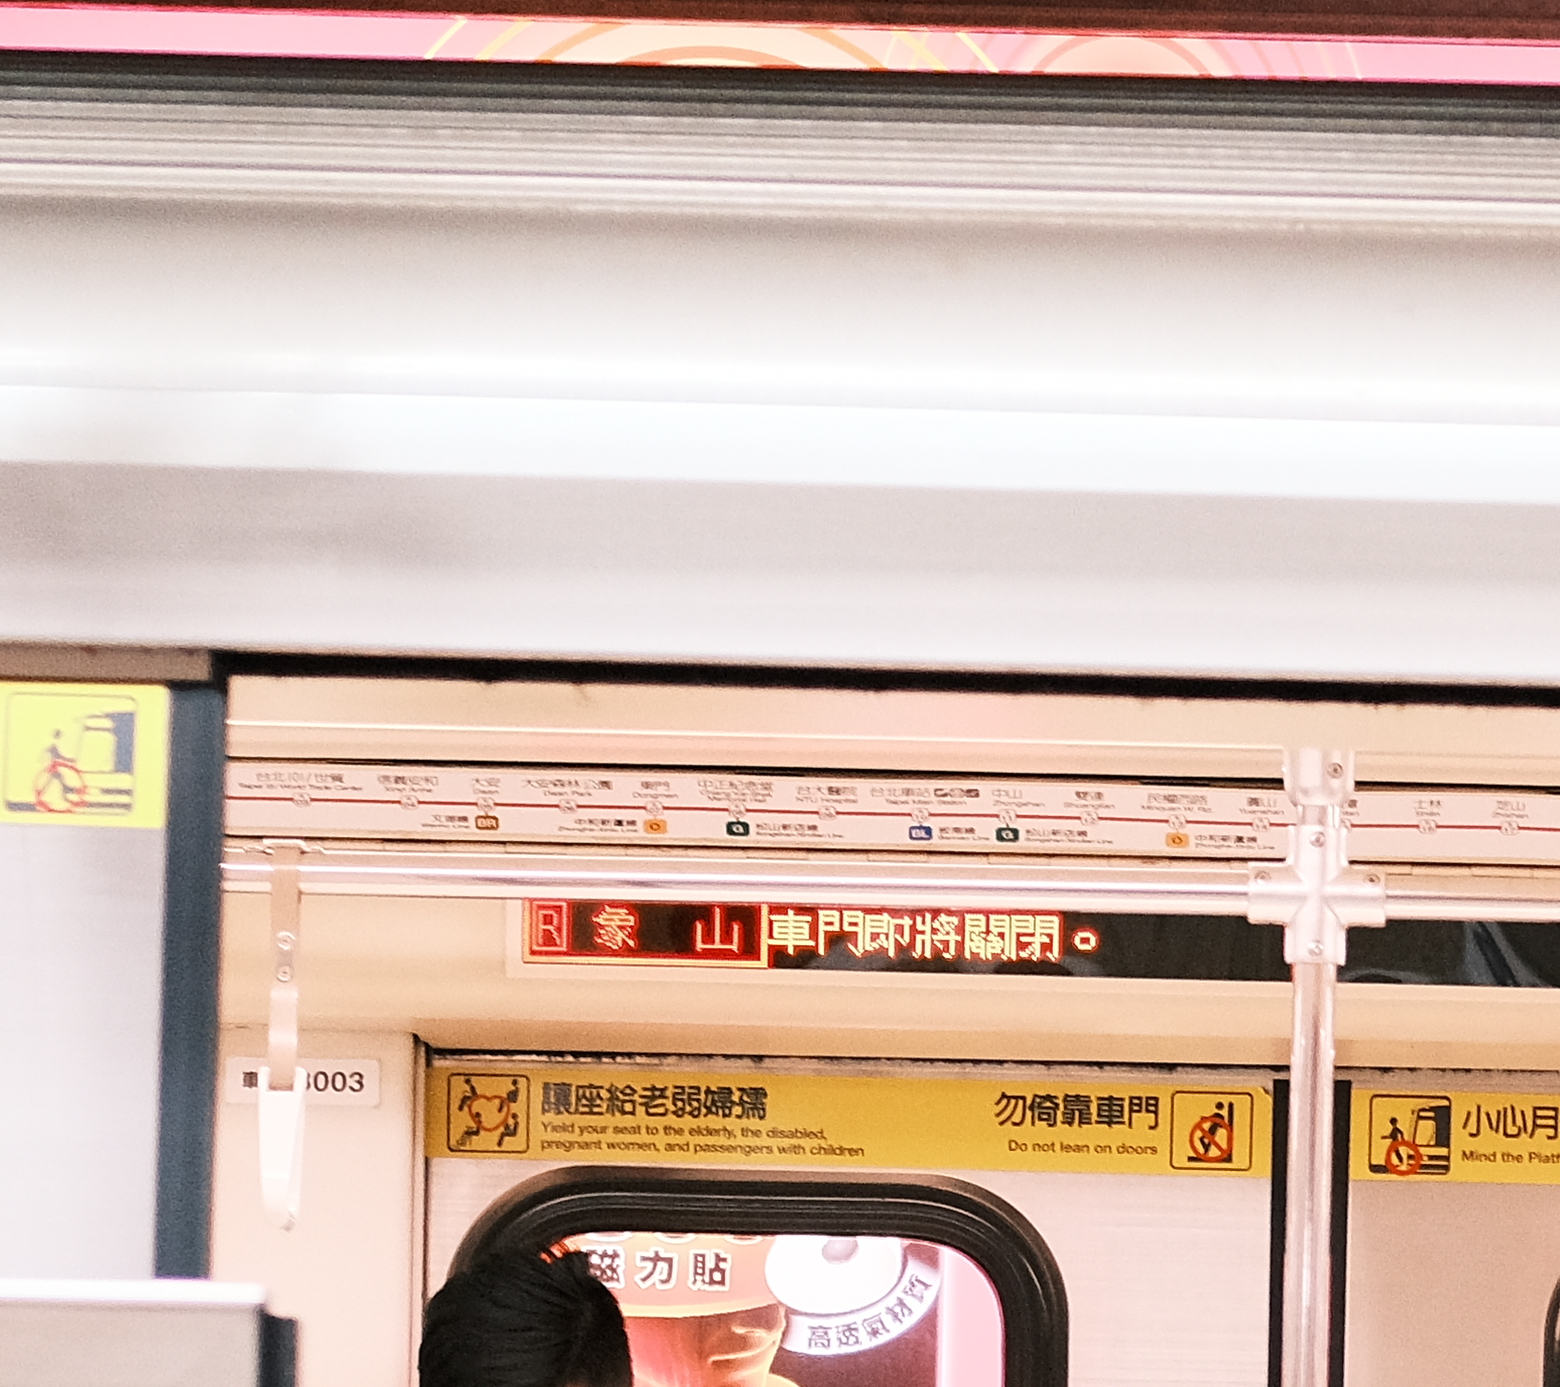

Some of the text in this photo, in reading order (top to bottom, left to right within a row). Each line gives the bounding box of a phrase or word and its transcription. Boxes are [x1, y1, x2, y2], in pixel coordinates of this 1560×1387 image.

[541, 1081, 769, 1122] 讓座給老弱婦孺
[994, 1092, 1160, 1131] 勿倚靠車門
[541, 1121, 575, 1136] Yield
[578, 1124, 610, 1138] your
[612, 1124, 641, 1137] seat
[645, 1125, 659, 1138] to
[663, 1125, 686, 1138] the
[740, 1127, 763, 1140] the
[541, 1140, 603, 1155] pregnant
[664, 1141, 689, 1154] and
[693, 1144, 774, 1159] passengers
[776, 1143, 806, 1156] with
[810, 1144, 865, 1159] children
[1008, 1140, 1158, 1156] Do not lean on doors
[1461, 1149, 1497, 1164] Mind
[1501, 1151, 1523, 1166] the
